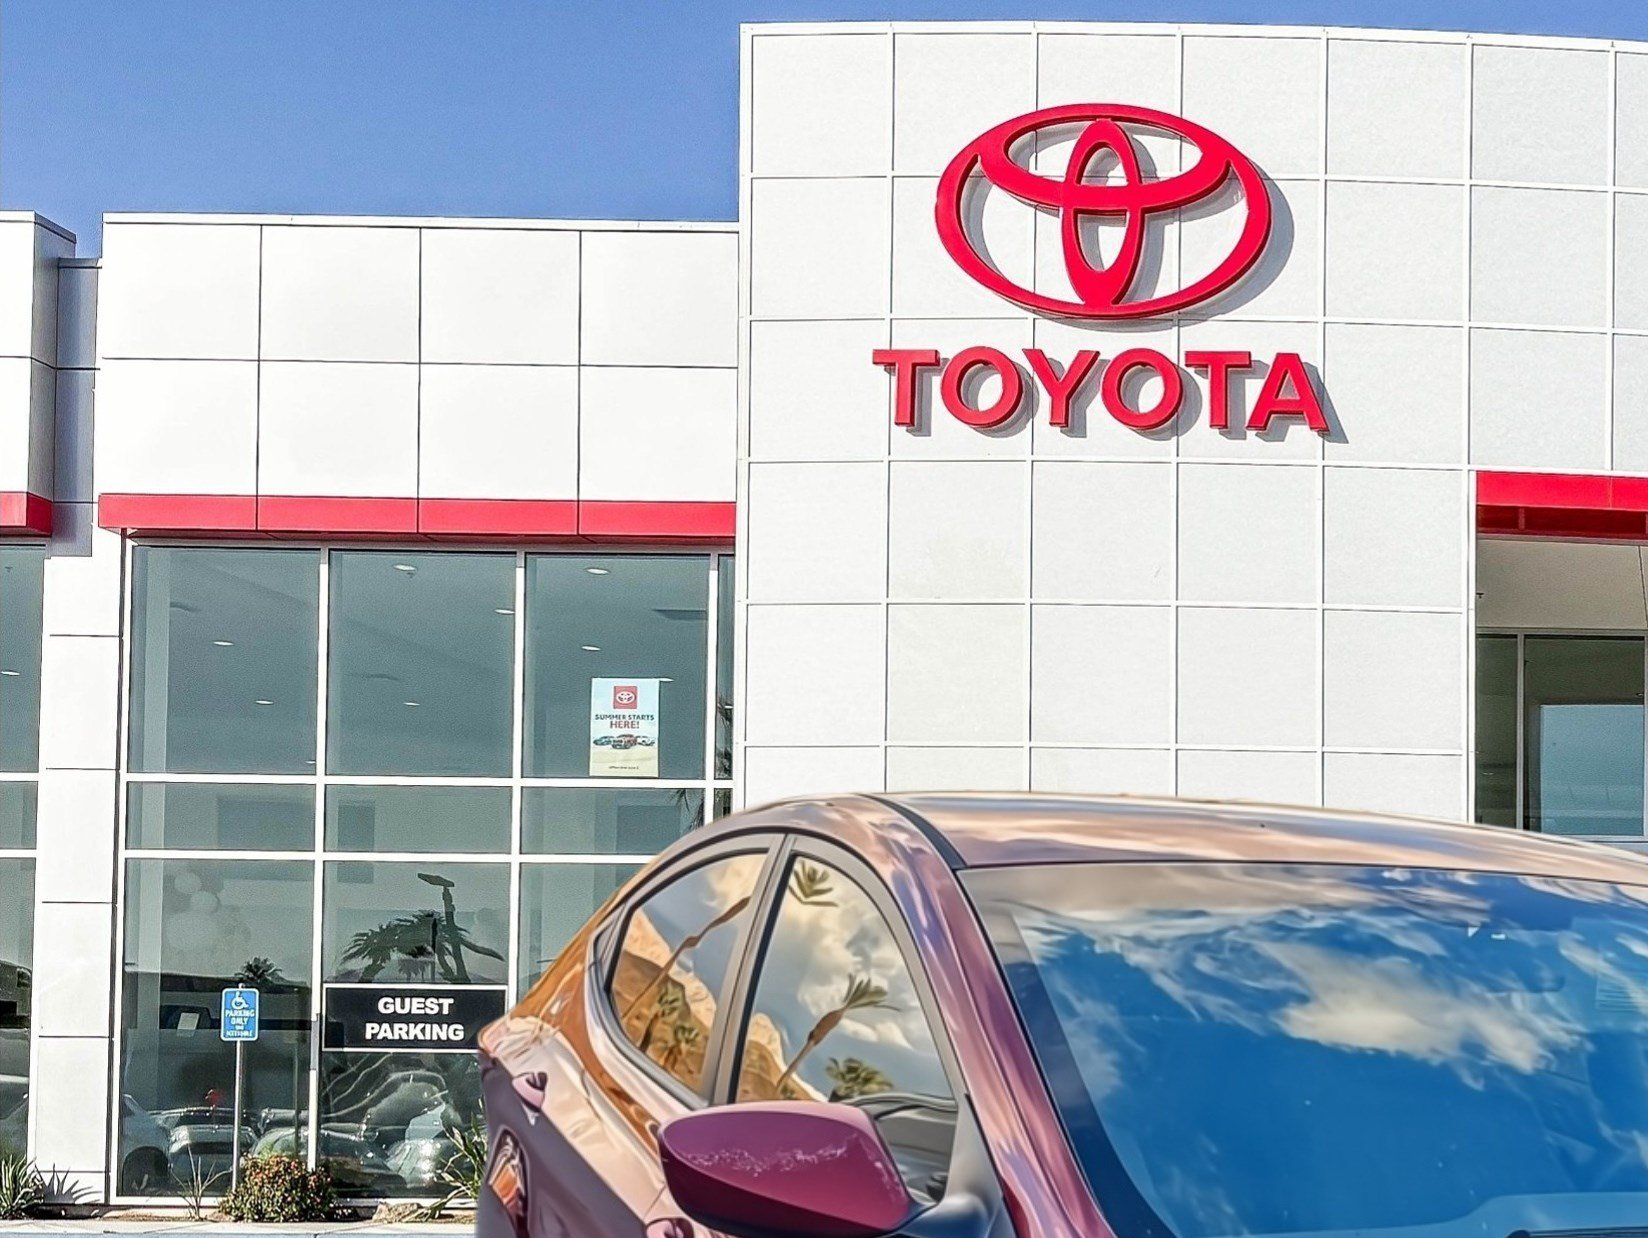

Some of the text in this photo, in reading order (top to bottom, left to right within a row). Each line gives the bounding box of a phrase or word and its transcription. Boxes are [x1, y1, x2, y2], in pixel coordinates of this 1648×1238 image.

[872, 346, 1330, 434] TOYOTA
[609, 720, 640, 729] HERE!
[378, 997, 454, 1015] GUEST
[225, 1009, 255, 1017] PARKING
[230, 1017, 249, 1025] ONLY
[365, 1022, 465, 1041] PARKING
